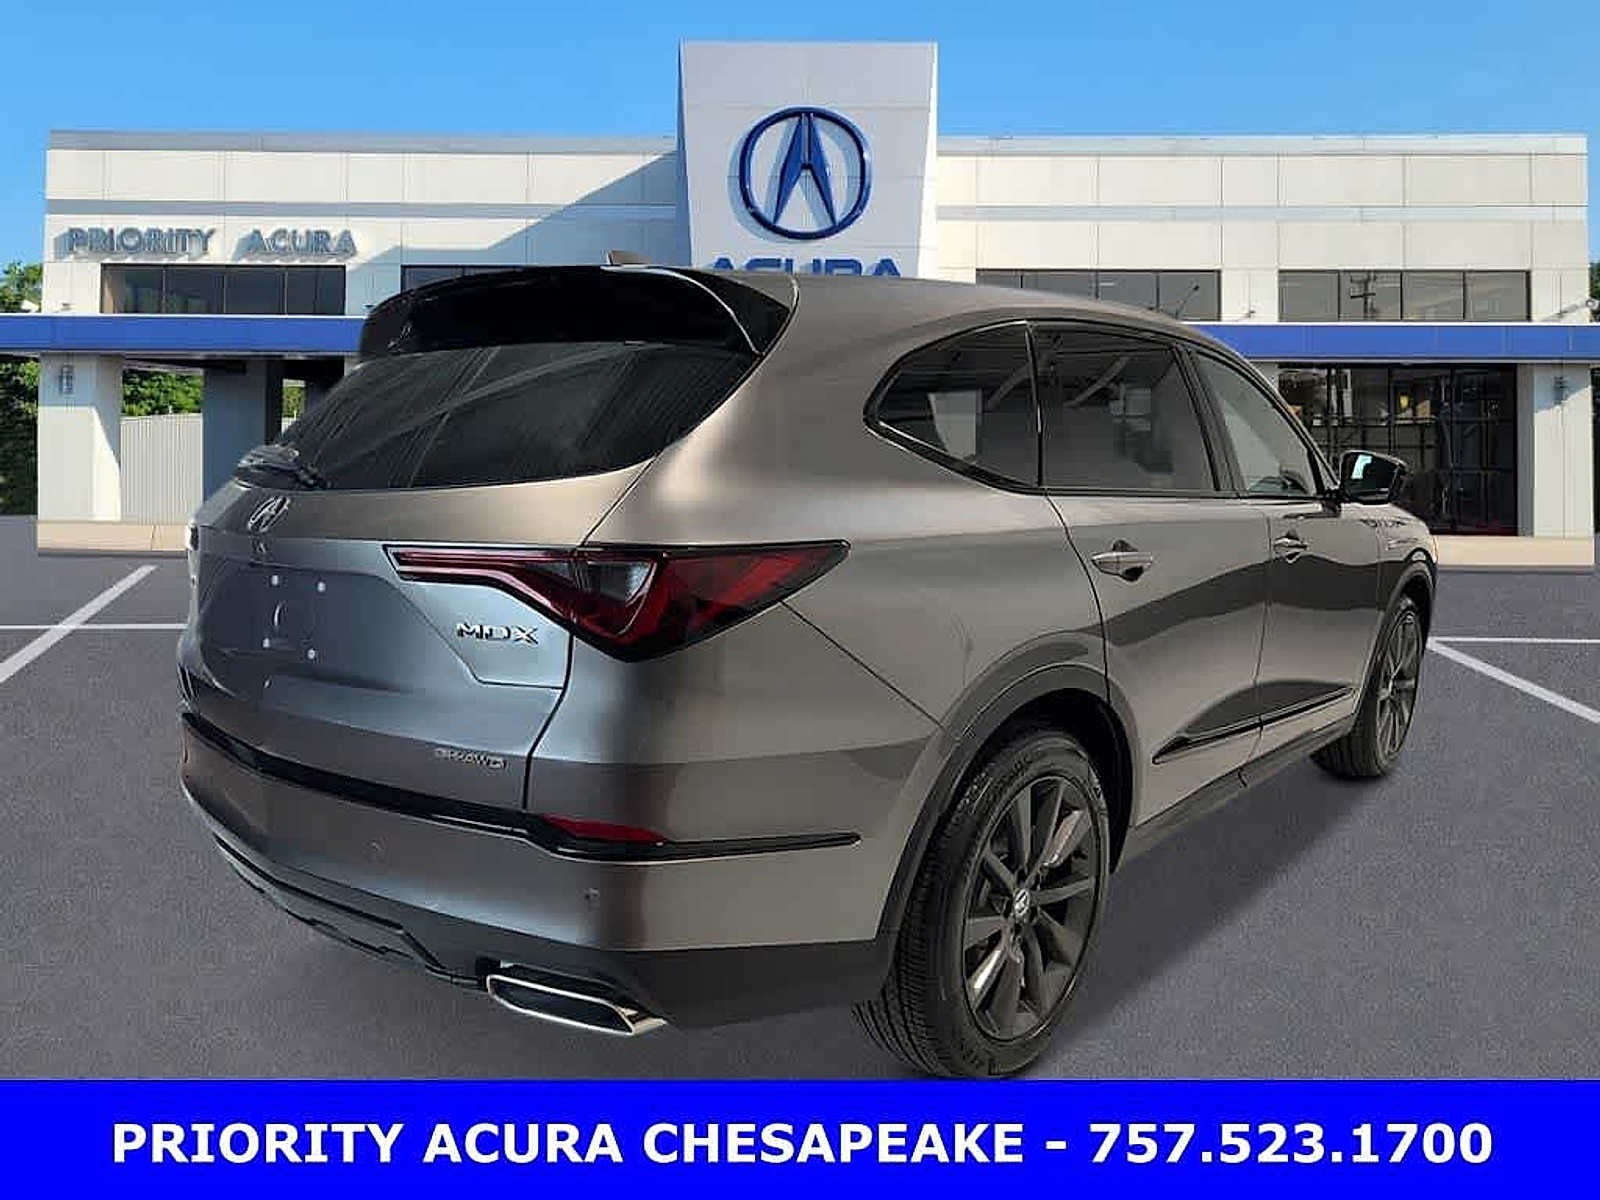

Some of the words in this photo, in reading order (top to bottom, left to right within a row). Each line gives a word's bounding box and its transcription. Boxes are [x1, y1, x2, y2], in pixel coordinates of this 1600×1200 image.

[66, 227, 216, 253] PRIORITY
[246, 228, 357, 256] ACURA
[456, 622, 539, 645] MDX
